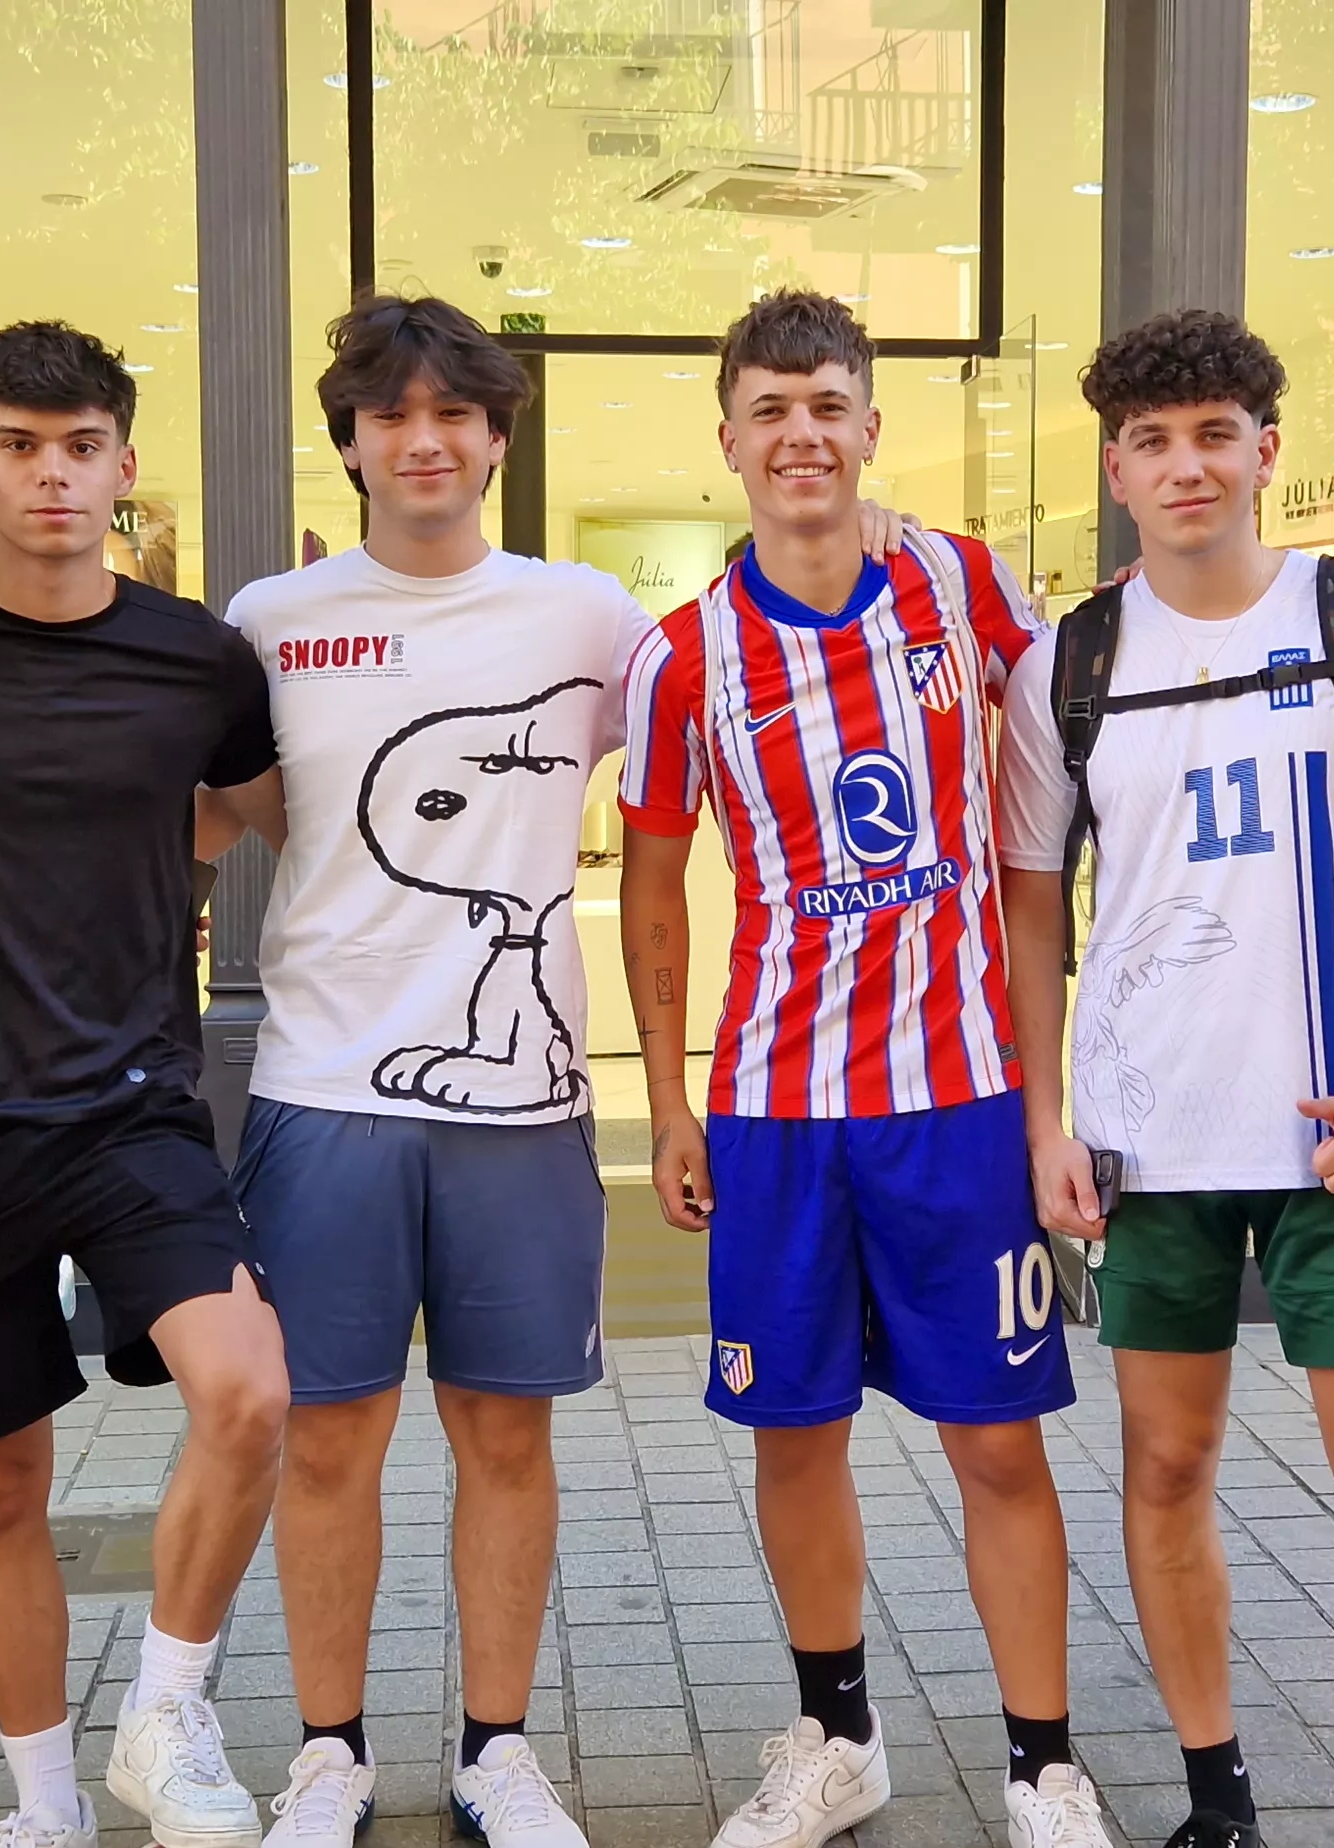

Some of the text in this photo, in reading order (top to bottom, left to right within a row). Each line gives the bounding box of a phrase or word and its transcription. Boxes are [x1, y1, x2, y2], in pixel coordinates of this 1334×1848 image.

[628, 555, 675, 597] Júlia
[278, 636, 389, 673] SNOOPY
[1184, 756, 1276, 863] 11
[803, 861, 957, 914] RIYADH AIR
[993, 1241, 1054, 1340] 10
